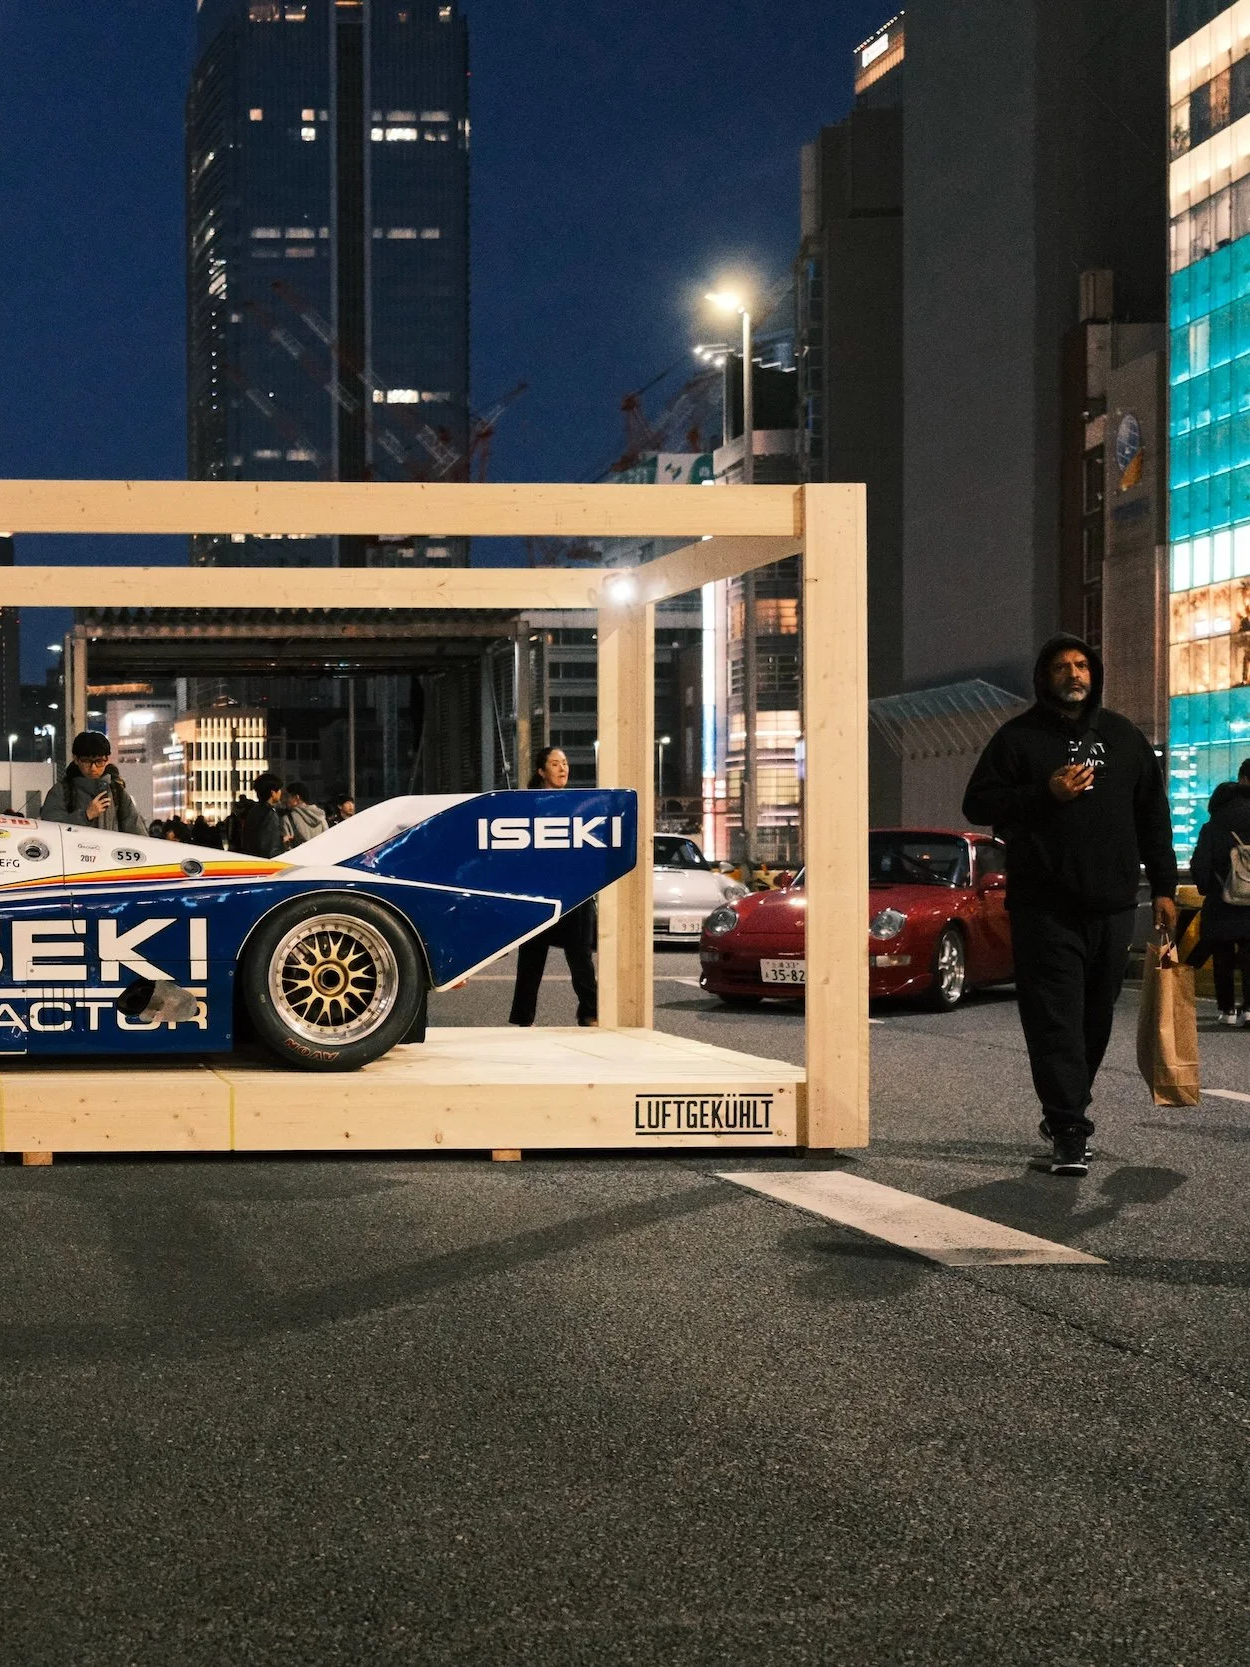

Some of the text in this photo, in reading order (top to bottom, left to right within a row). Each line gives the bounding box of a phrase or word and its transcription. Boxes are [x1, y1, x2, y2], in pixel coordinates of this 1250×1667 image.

[478, 816, 622, 850] ISEKI
[117, 851, 141, 862] 559
[771, 969, 806, 982] 35-82
[285, 1038, 340, 1061] AVON
[635, 1093, 774, 1129] LUFTGEKÜHLT
